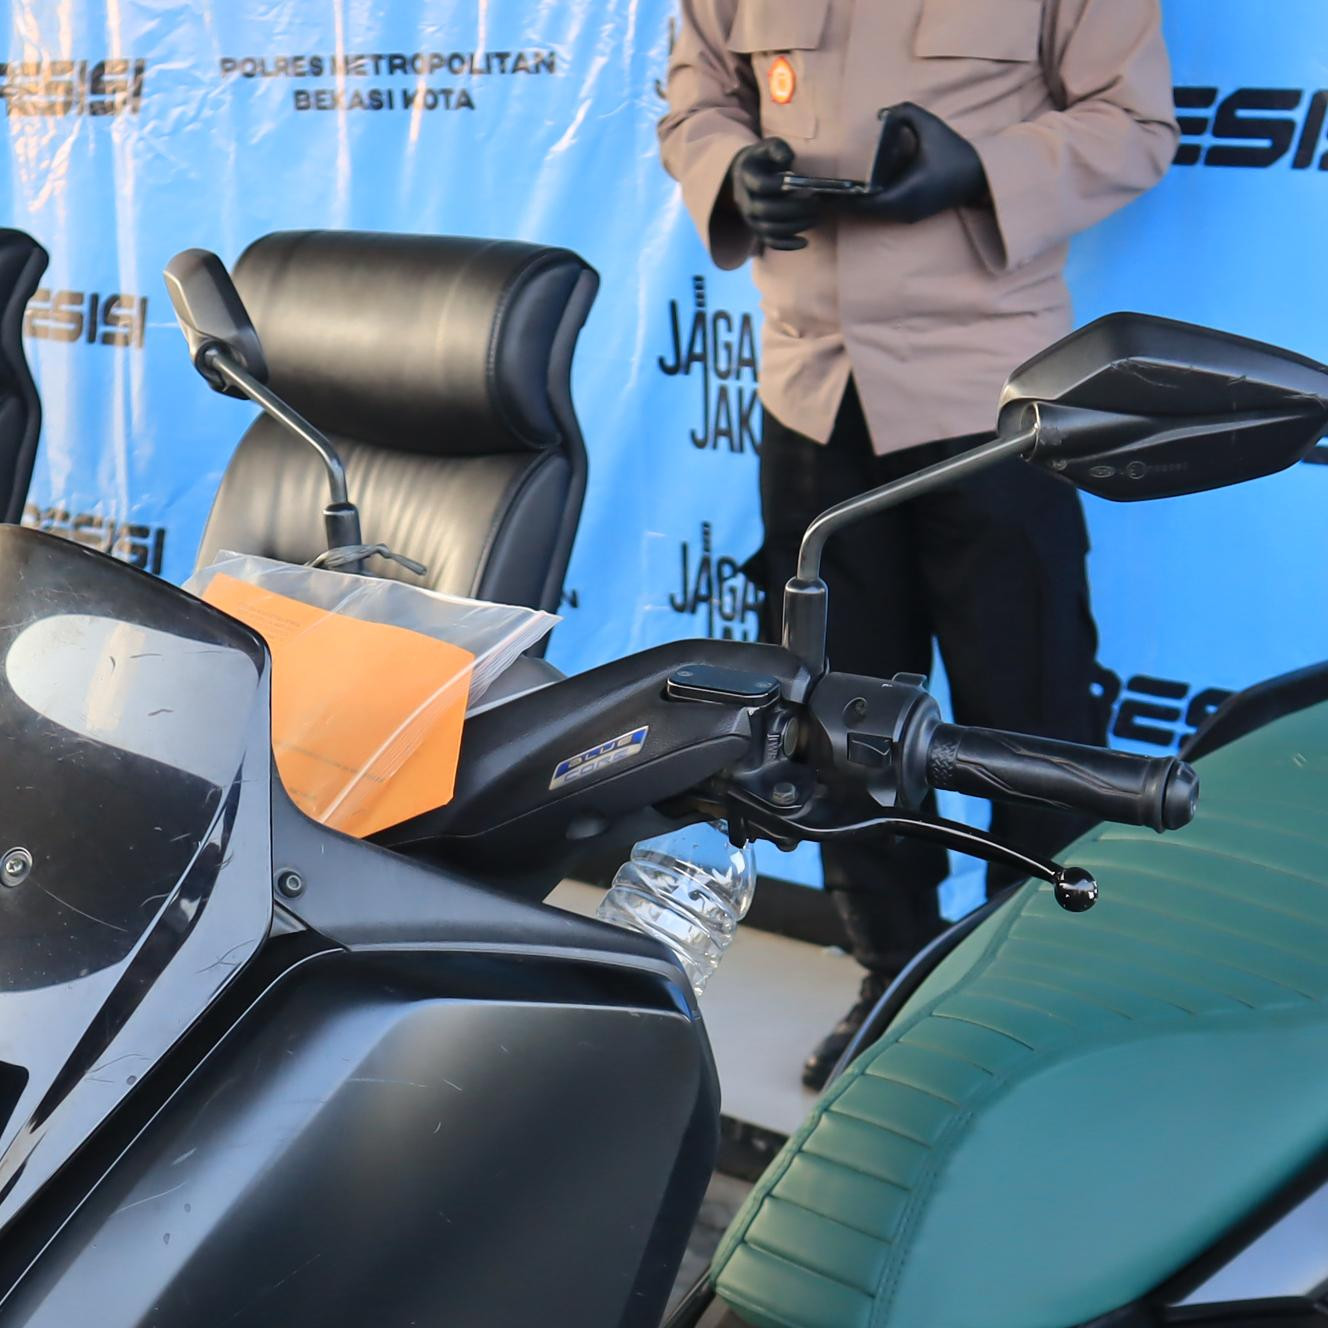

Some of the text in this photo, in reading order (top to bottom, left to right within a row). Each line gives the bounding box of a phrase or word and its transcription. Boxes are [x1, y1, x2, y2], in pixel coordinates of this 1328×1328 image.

[219, 50, 557, 78] POLRES METROPOLITAN
[294, 87, 476, 111] BEKASI KOTA
[26, 288, 149, 348] ESISI
